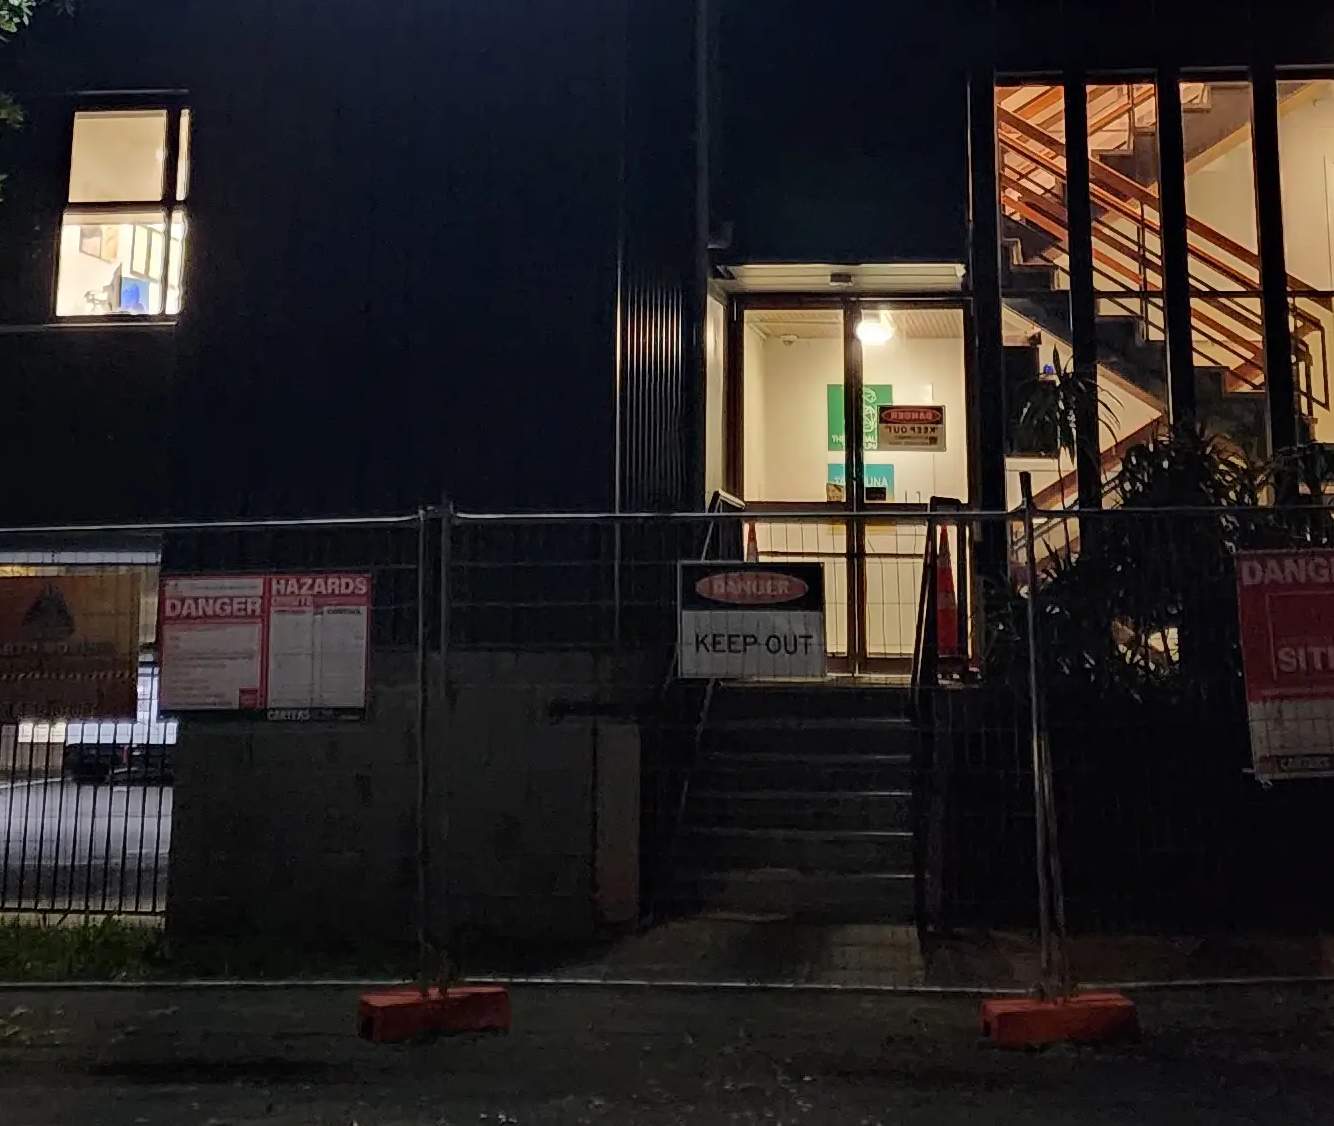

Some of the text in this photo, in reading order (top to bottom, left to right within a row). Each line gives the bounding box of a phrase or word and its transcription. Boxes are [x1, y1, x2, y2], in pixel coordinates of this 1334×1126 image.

[271, 577, 368, 596] HAZARDS
[711, 578, 791, 596] DANGER
[164, 596, 262, 618] DANGER
[695, 633, 815, 655] KEEP OUT
